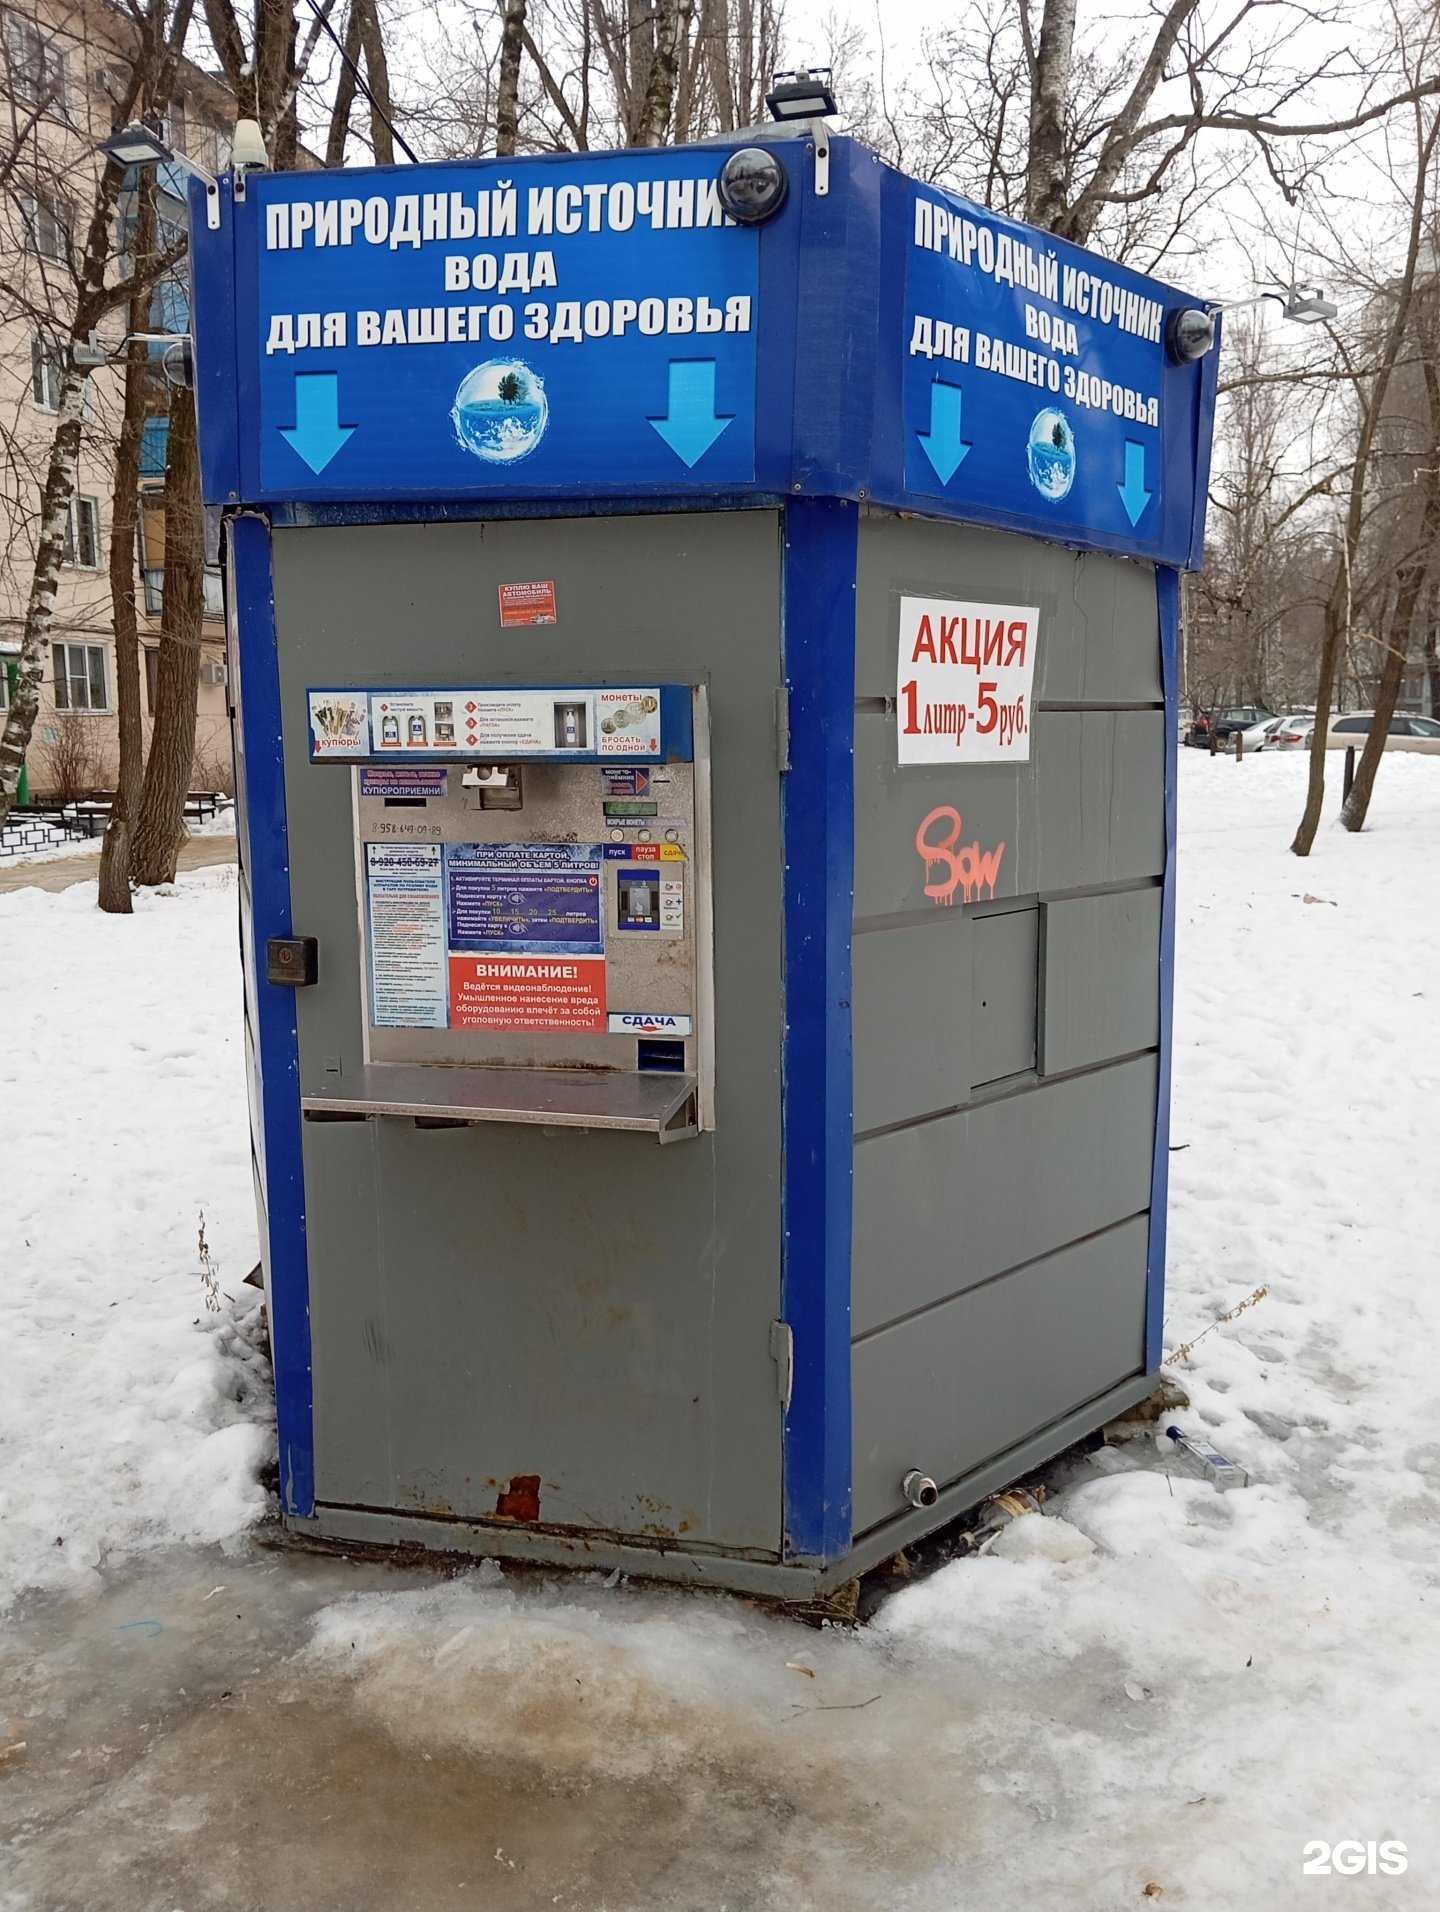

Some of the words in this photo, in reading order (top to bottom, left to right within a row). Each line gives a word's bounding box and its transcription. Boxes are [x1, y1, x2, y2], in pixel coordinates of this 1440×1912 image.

[266, 180, 517, 250] ПРИРОДНЫЙ
[528, 178, 738, 236] ИСТОЧНИ
[445, 251, 558, 294] ВОДА
[915, 198, 1058, 302] ПРИРОДНЫЙ
[1063, 265, 1163, 343] ИСТОЧНИК
[266, 312, 347, 355] ДЛЯ
[357, 304, 514, 346] ВАШЕГО
[524, 295, 751, 344] ЗДОРОВЬЯ
[1026, 304, 1078, 356] ВОДА
[911, 316, 969, 363] ДЛЯ
[976, 332, 1060, 392] ВАШЕГО
[1064, 369, 1158, 427] ЗДОРОВЬЯ
[912, 615, 1028, 675] АКЦИЯ
[616, 744, 645, 752] ОДНОЙ
[363, 786, 446, 795] КУПЮРОПРИЕМНИ
[496, 851, 531, 859] ОПЛАТЕ
[533, 851, 570, 860] КАРТОЙ,
[635, 846, 656, 854] пауза
[449, 860, 518, 868] МИНИМАЛЬНЫЙ
[476, 965, 578, 979] ВНИМАНИЕ!
[463, 982, 501, 992] Ведётся
[503, 983, 592, 993] видеонаблюдение!
[458, 993, 517, 1002] Умышленное
[570, 997, 599, 1005] вреда
[456, 1005, 524, 1014] оборудованию
[526, 1006, 558, 1014] влечёт
[572, 1006, 601, 1016] собой
[462, 1018, 512, 1028] уголовную
[514, 1018, 595, 1027] ответственность!
[622, 1016, 676, 1026] СДАЧА
